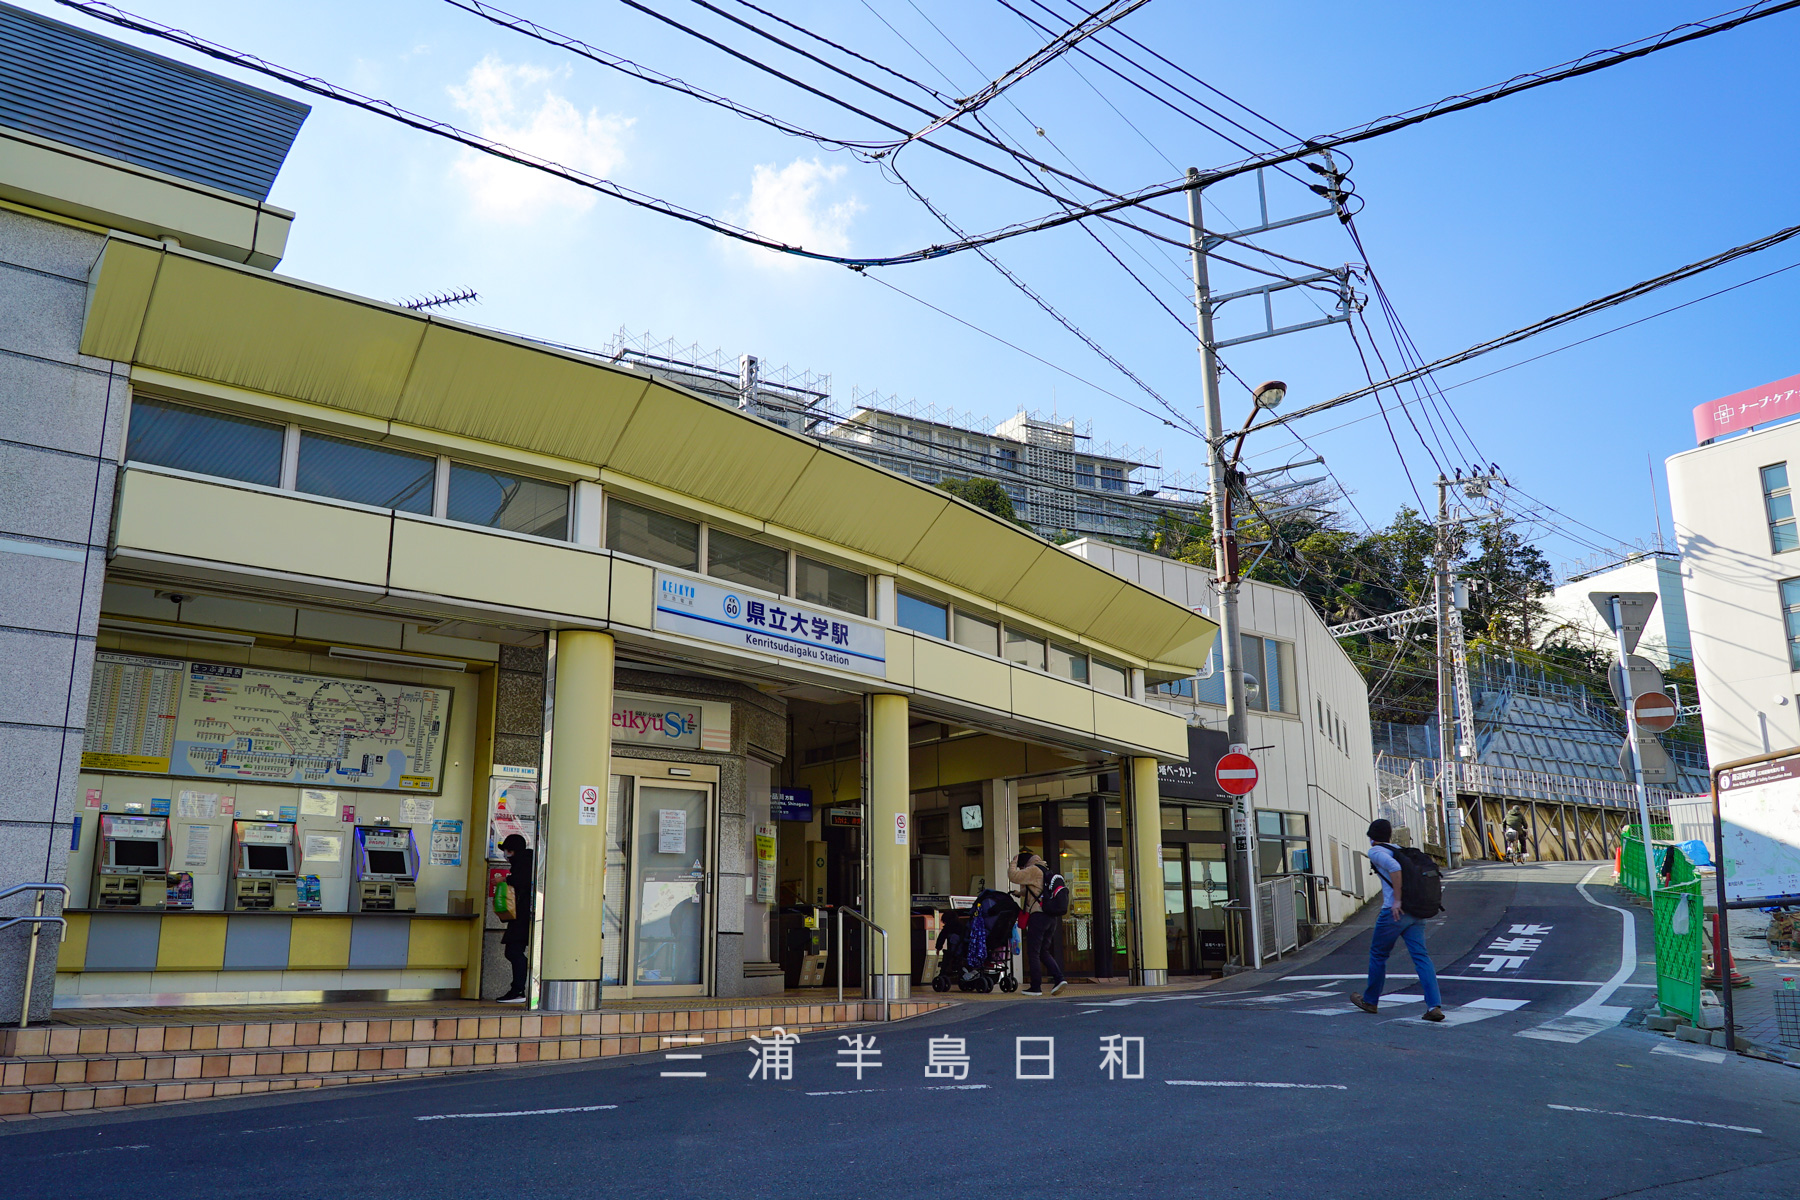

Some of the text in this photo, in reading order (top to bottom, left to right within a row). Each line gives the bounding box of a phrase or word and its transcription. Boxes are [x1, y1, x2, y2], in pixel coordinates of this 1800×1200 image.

[1738, 389, 1800, 415] ナーブ・ケア・
[662, 580, 695, 599] KEIKYU
[726, 604, 738, 615] 60
[746, 600, 849, 646] 県立大学駅
[746, 634, 850, 666] Kenritsudaigaku Station
[611, 709, 664, 734] eikyu
[1157, 765, 1198, 778] 塔ベーカリー
[1469, 923, 1554, 973] 止まれ
